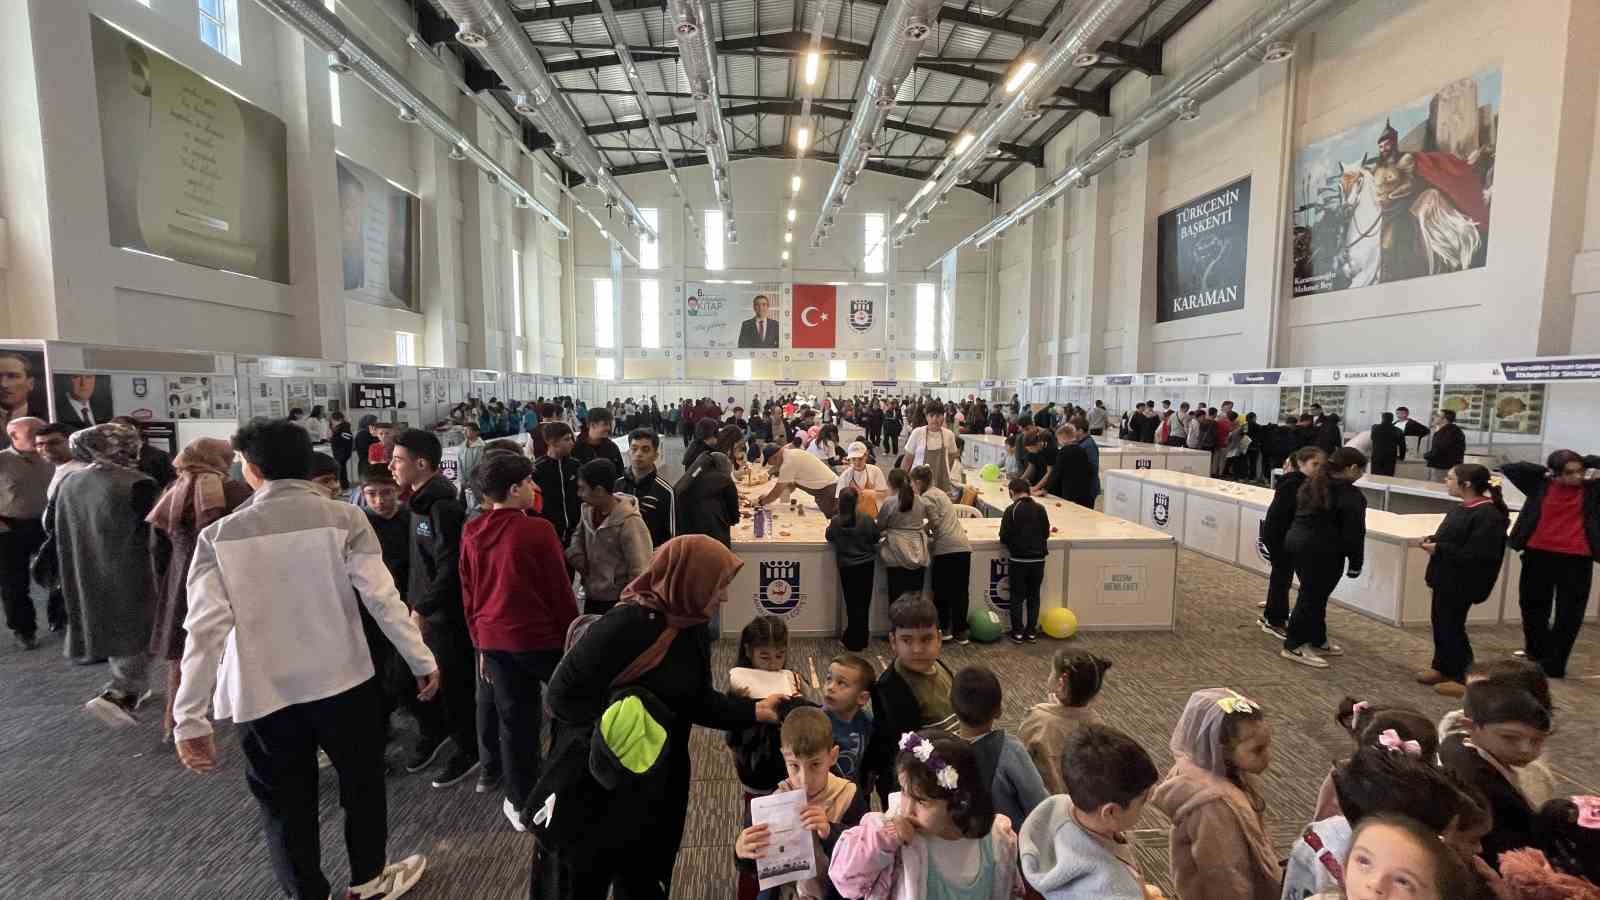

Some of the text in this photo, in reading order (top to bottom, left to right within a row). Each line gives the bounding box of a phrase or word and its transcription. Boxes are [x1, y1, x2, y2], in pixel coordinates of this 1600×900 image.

[1176, 188, 1240, 225] TÜRKÇENİN
[1181, 207, 1232, 241] BAŞKENTİ
[1173, 285, 1238, 313] KARAMAN
